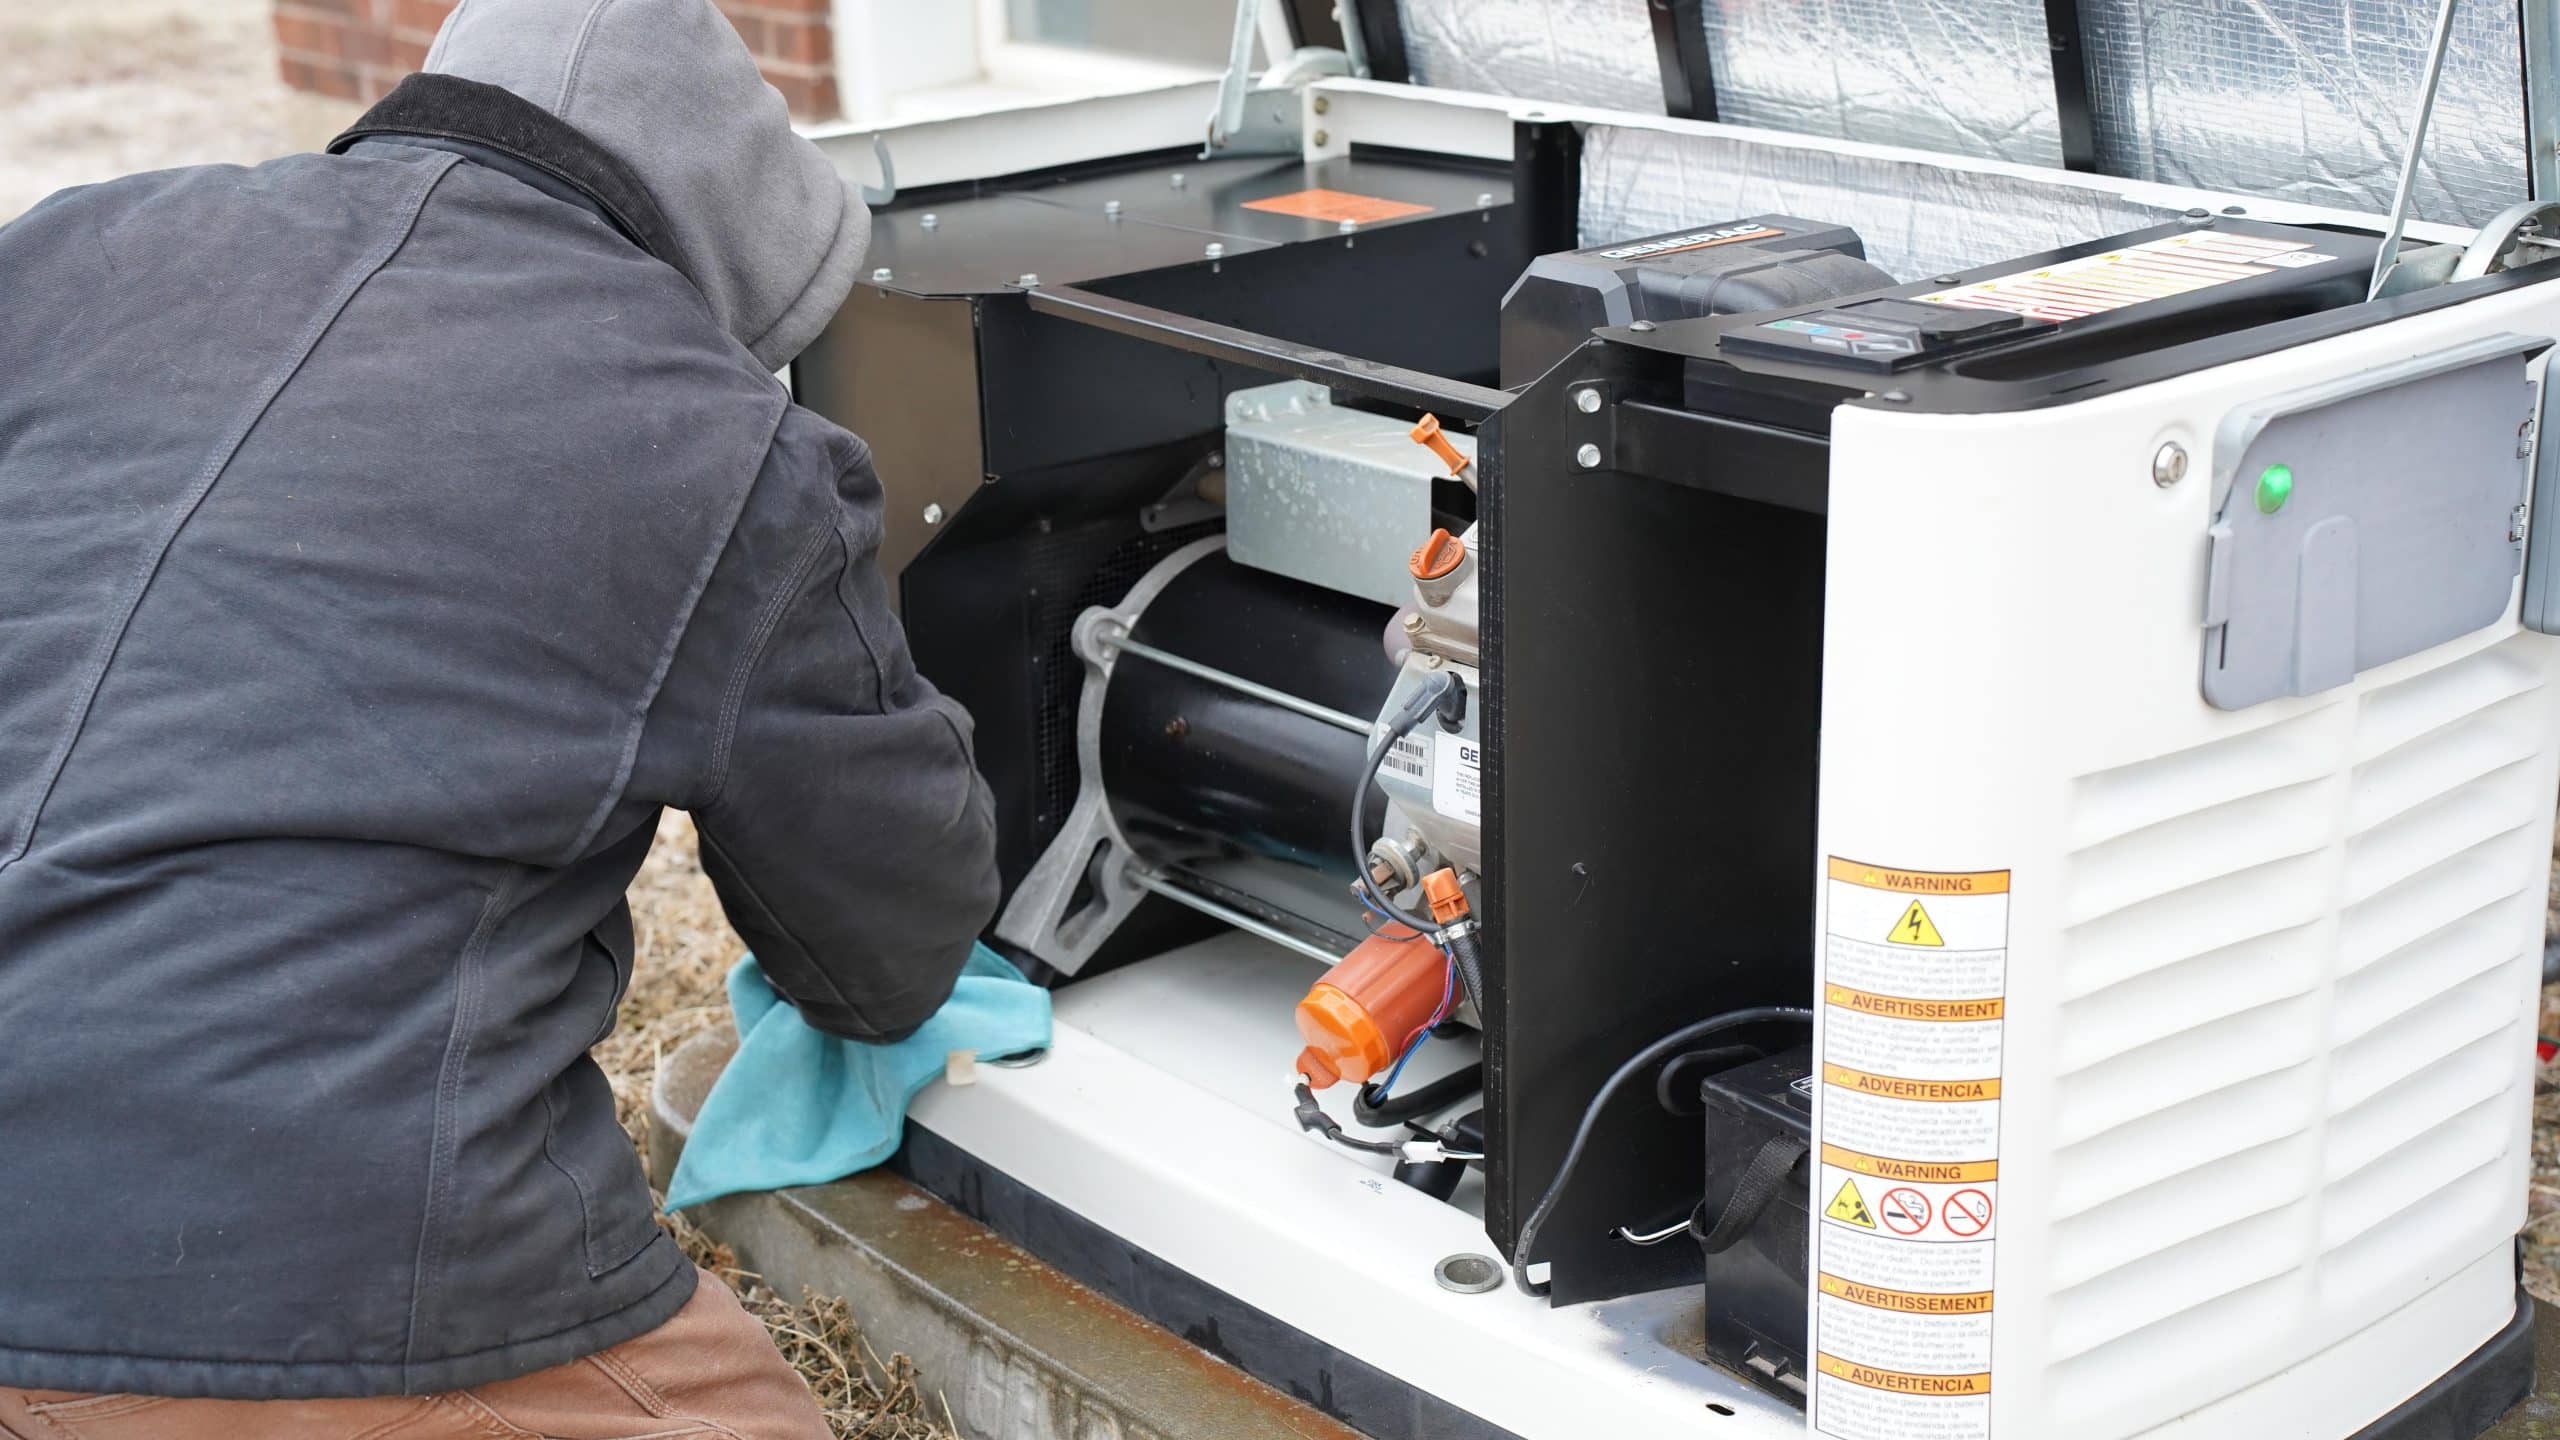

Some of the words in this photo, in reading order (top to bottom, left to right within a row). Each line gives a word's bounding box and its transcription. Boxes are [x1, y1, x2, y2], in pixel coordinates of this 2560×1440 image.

[1599, 223, 1766, 260] GENERAC
[1884, 873, 1972, 892] WARNING
[1851, 994, 1999, 1017] AVERTISSEMENT
[1858, 1076, 1984, 1098] ADVERTENCIA
[1876, 1161, 1962, 1180] WARNING
[1844, 1285, 1988, 1311] AVERTISSEMENT
[1851, 1367, 1975, 1392] ADVERTENCIA
